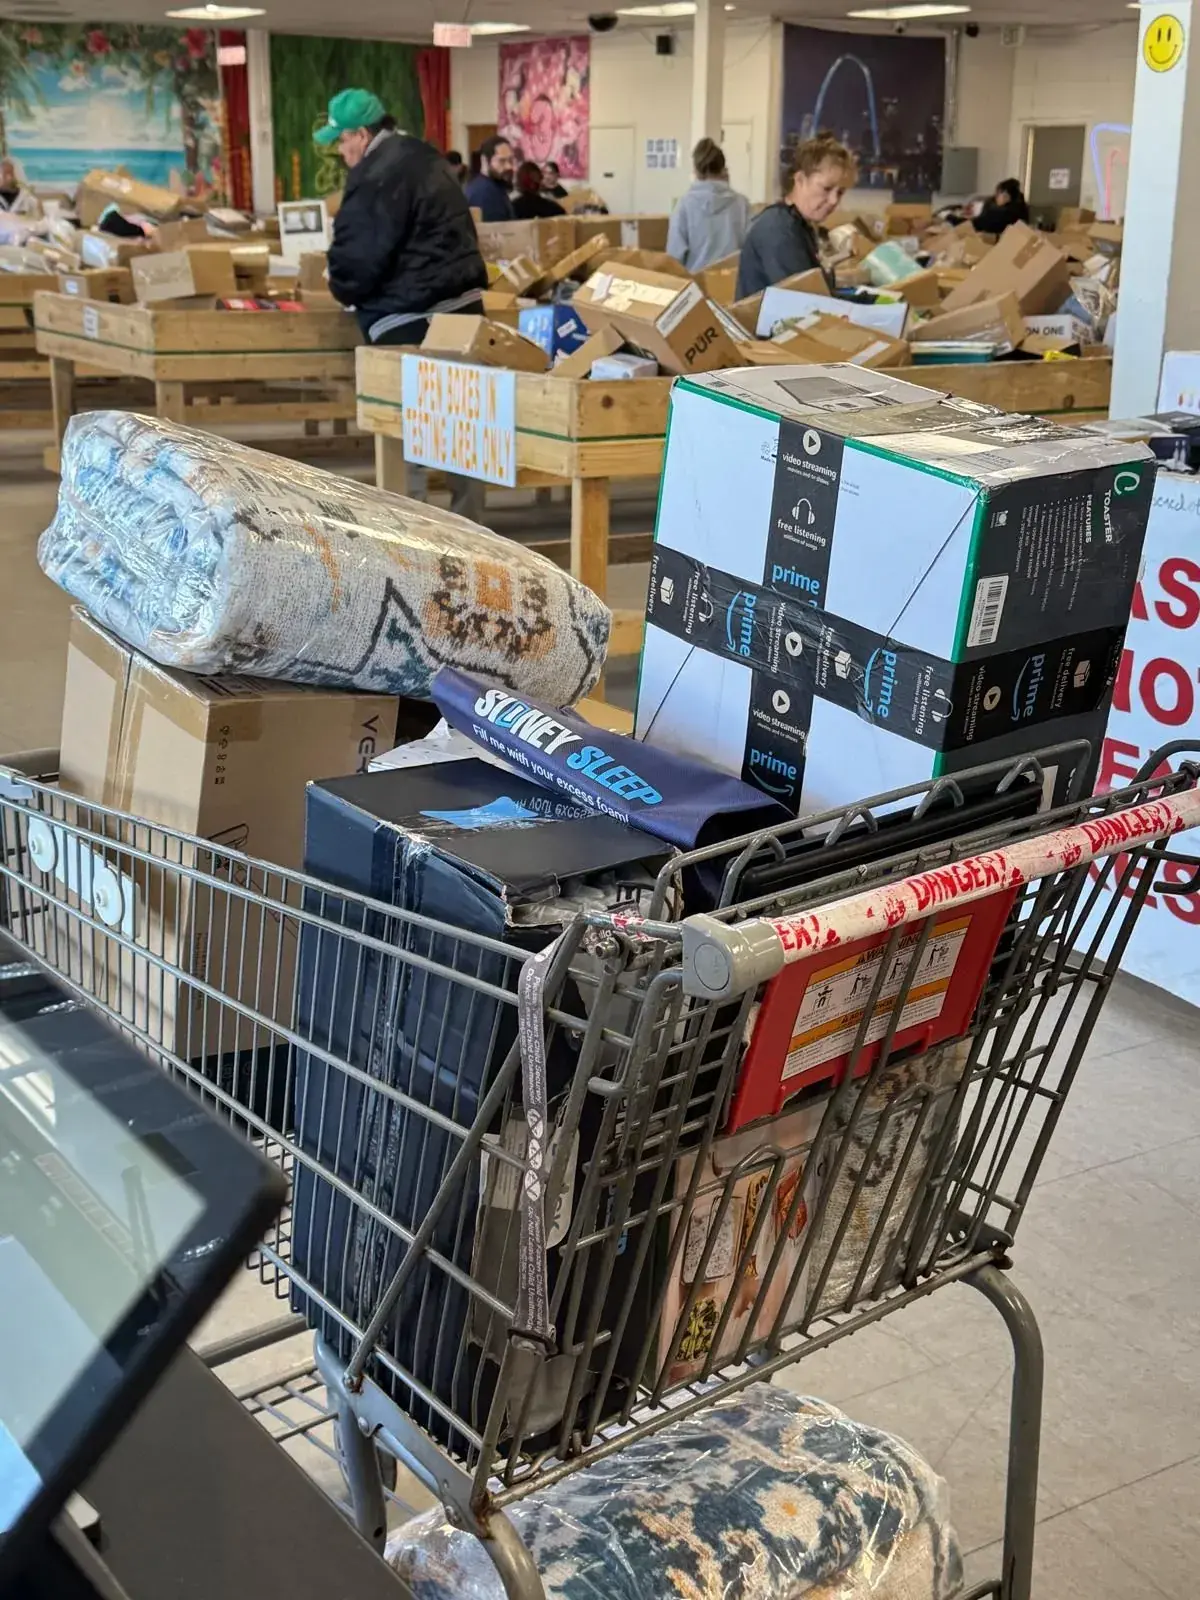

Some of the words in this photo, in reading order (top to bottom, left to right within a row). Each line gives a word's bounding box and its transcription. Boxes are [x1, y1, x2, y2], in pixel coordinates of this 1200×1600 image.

[1042, 324, 1065, 336] ONE
[418, 360, 442, 412] OPEN
[447, 366, 480, 420] BOXES
[485, 371, 496, 423] IN
[406, 407, 447, 464] TESTING
[452, 418, 478, 472] AREA
[483, 426, 511, 481] ONLY
[782, 453, 801, 466] video
[802, 460, 837, 480] streaming
[777, 518, 793, 532] free
[794, 524, 826, 547] listening
[1104, 490, 1113, 544] TOASTER
[652, 555, 660, 576] free
[772, 564, 820, 596] prime
[647, 576, 658, 614] delivery
[686, 592, 699, 636] listening
[740, 592, 756, 658] prime
[777, 602, 786, 626] video
[770, 628, 782, 674] streaming
[825, 626, 834, 648] free
[820, 649, 830, 688] delivery
[924, 665, 934, 686] free
[1064, 647, 1076, 668] free
[877, 649, 898, 718] prime
[975, 665, 986, 692] video
[1023, 653, 1046, 718] prime
[1054, 669, 1070, 708] delivery
[752, 708, 771, 724] video
[772, 716, 806, 740] streaming
[915, 688, 930, 735] listening
[966, 692, 980, 741] streaming
[472, 724, 488, 742] Fill
[490, 736, 506, 752] me
[506, 744, 530, 768] with
[530, 760, 554, 782] your
[556, 776, 594, 806] excess
[596, 796, 630, 823] foam!
[566, 745, 663, 806] SLEEP
[750, 748, 798, 780] prime
[1081, 802, 1172, 854] DANGER!
[910, 850, 1008, 912] DANGER!
[774, 914, 820, 951] ER!
[863, 934, 922, 962] WANIN
[526, 968, 534, 982] Do
[534, 1040, 542, 1064] Child
[528, 1206, 534, 1218] Do
[526, 1288, 535, 1330] Unattende
[534, 1297, 544, 1333] Securely
